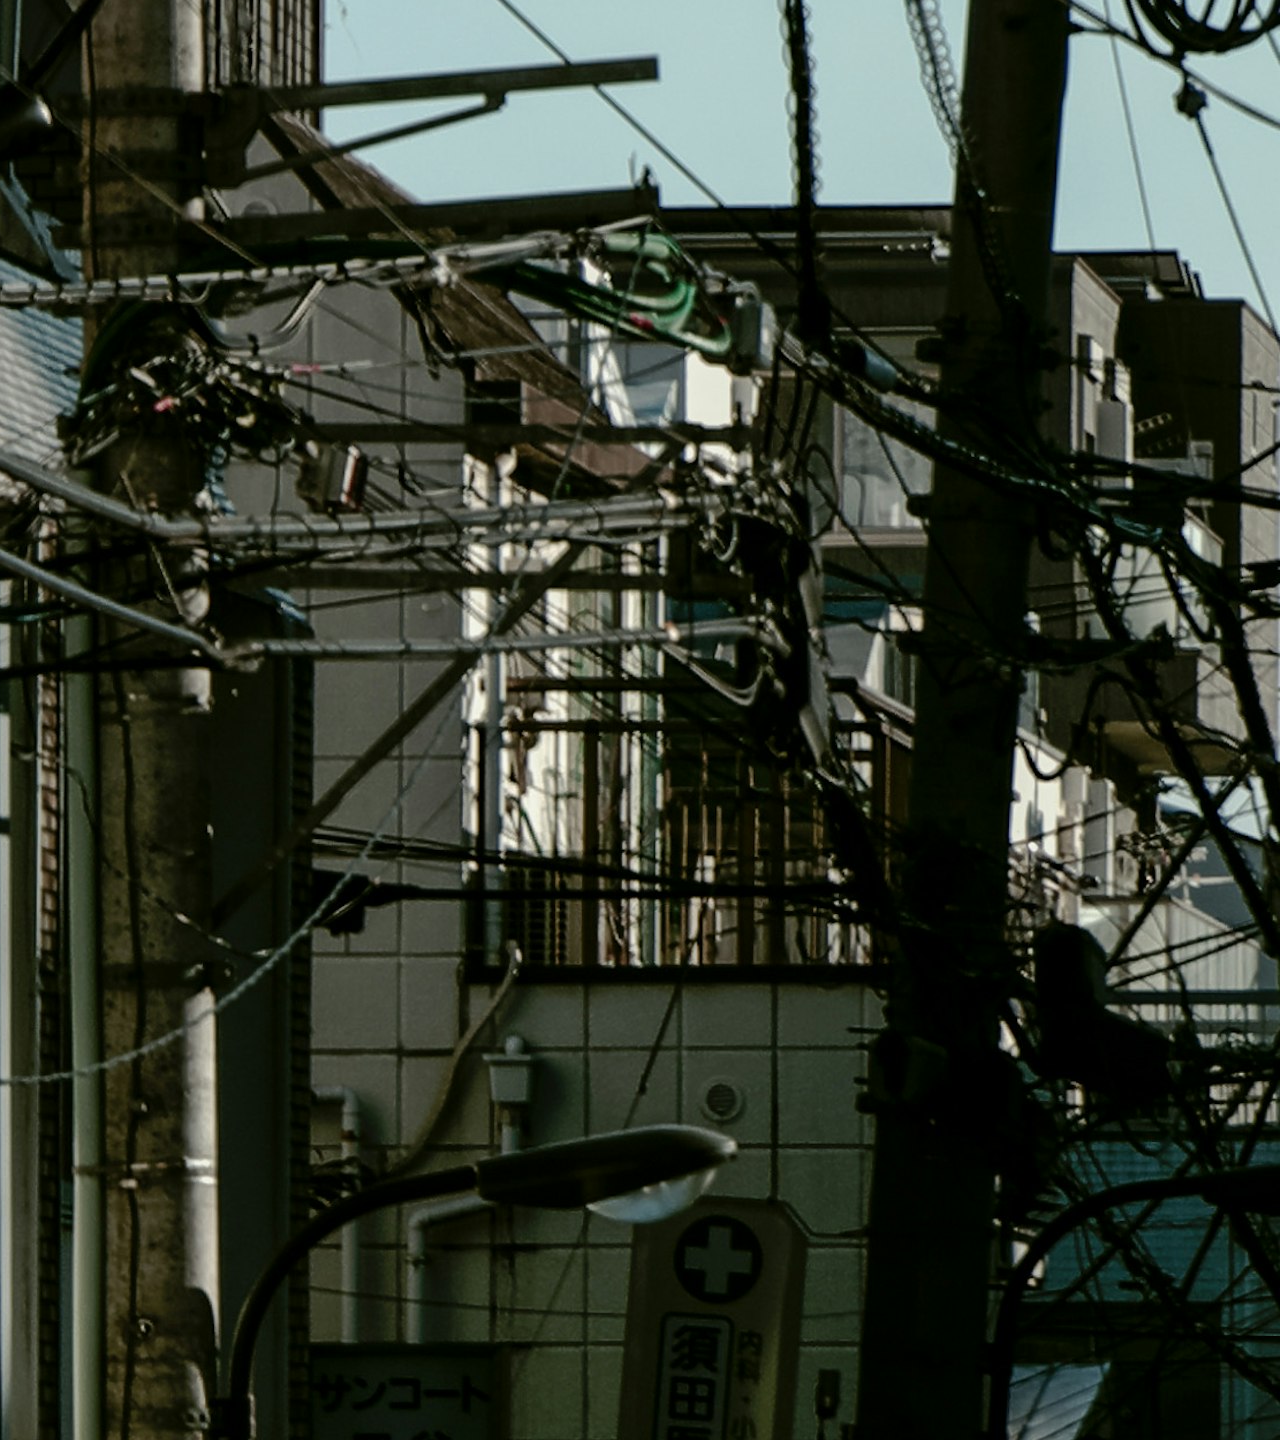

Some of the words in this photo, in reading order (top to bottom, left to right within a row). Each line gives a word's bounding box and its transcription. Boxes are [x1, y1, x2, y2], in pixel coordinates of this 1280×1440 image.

[312, 1373, 491, 1414] サンコート
